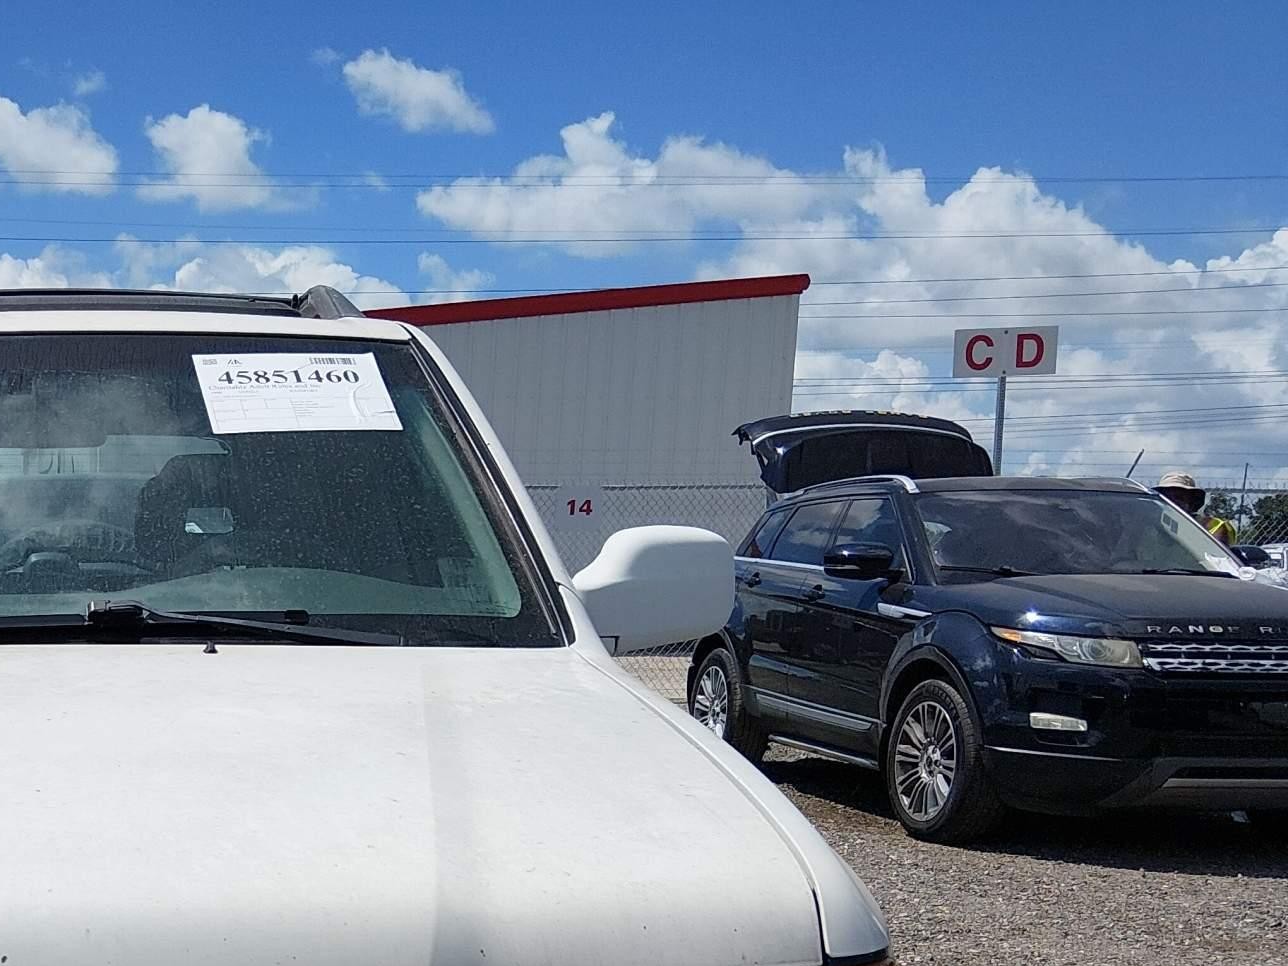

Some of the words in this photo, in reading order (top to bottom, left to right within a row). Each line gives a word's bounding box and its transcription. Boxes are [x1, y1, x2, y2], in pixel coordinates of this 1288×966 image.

[965, 334, 994, 371] C
[1015, 333, 1045, 368] D
[218, 369, 360, 385] 45851460
[567, 499, 593, 516] 14
[1146, 625, 1240, 634] RANGE
